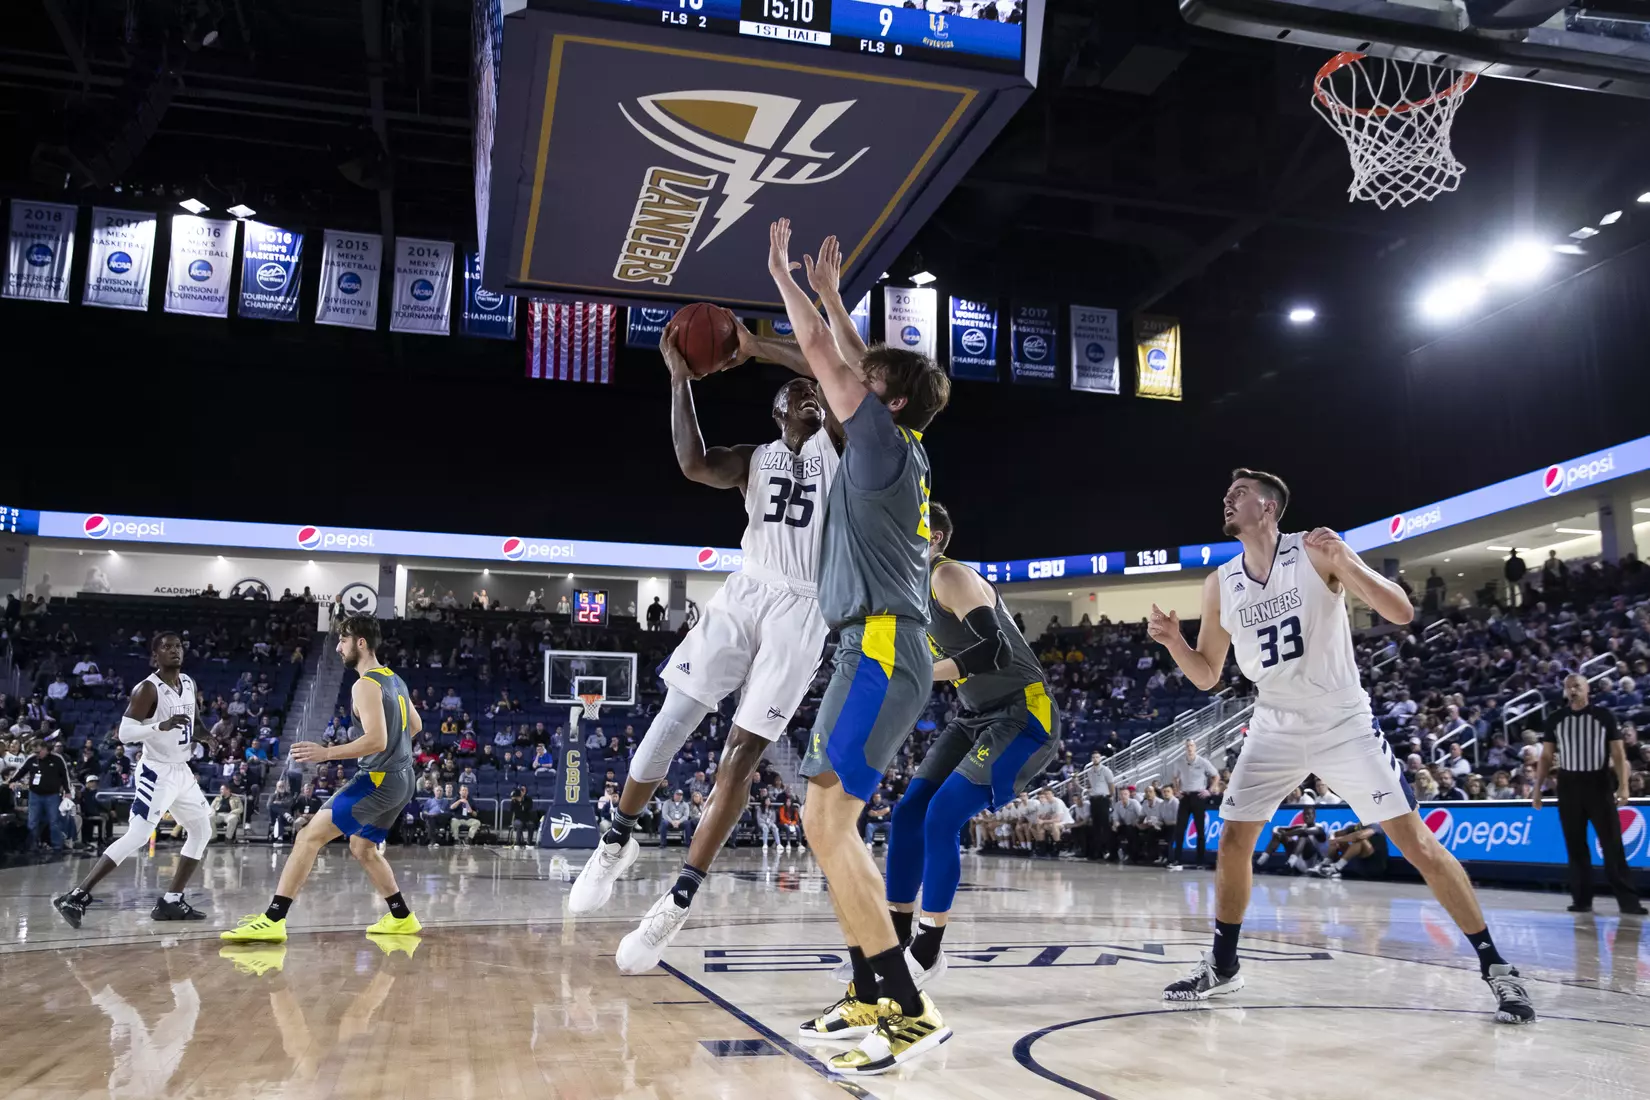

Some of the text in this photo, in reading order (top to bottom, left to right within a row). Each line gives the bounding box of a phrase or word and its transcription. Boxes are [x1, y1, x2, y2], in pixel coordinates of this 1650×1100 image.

[763, 0, 814, 23] 15:10
[661, 10, 707, 28] FLS 2
[879, 8, 893, 37] 9
[755, 25, 820, 42] 1ST HALF
[860, 39, 903, 56] FLS 0
[24, 208, 62, 222] 2018
[105, 216, 140, 228] 2017
[613, 166, 719, 286] LANCERS
[258, 243, 287, 253] MEN'S
[335, 238, 369, 251] 2015
[337, 252, 365, 261] MEN'S
[407, 246, 440, 258] 2014
[109, 261, 131, 270] NCAA
[325, 260, 378, 271] BASKETBALL
[409, 260, 436, 268] MEN'S
[190, 269, 212, 277] NCAA
[96, 277, 132, 286] DIVISION
[340, 281, 361, 290] NCAA
[87, 283, 144, 295] TOURNAMENT
[178, 284, 213, 294] DIVISION
[413, 288, 433, 296] NCAA
[169, 291, 225, 302] TOURNAMENT
[324, 296, 363, 307] DIVISION
[245, 301, 293, 312] CHAMPIONS
[326, 306, 368, 316] SWEET 16
[401, 304, 435, 313] DIVISION
[960, 299, 988, 312] 2017
[463, 312, 513, 323] CHAMPIONS
[955, 310, 991, 321] WOMEN'S
[1020, 307, 1048, 318] 2017
[1080, 313, 1107, 324] 2017
[952, 356, 997, 366] CHAMPIONS
[1566, 453, 1615, 488] pepsi
[763, 476, 817, 528] 35
[1405, 507, 1442, 535] pepsi
[112, 521, 165, 538] pepsi
[324, 532, 373, 549] pepsi
[528, 543, 574, 560] pepsi
[1136, 549, 1168, 566] 15:10
[1201, 546, 1211, 565] 9
[1090, 555, 1108, 574] 10
[1281, 557, 1296, 568] WAC
[1028, 559, 1066, 579] CBU
[578, 603, 601, 623] 22
[1239, 587, 1303, 628] LANCERS
[1257, 615, 1305, 669] 33
[565, 750, 581, 804] CBU
[1451, 815, 1533, 852] pepsi
